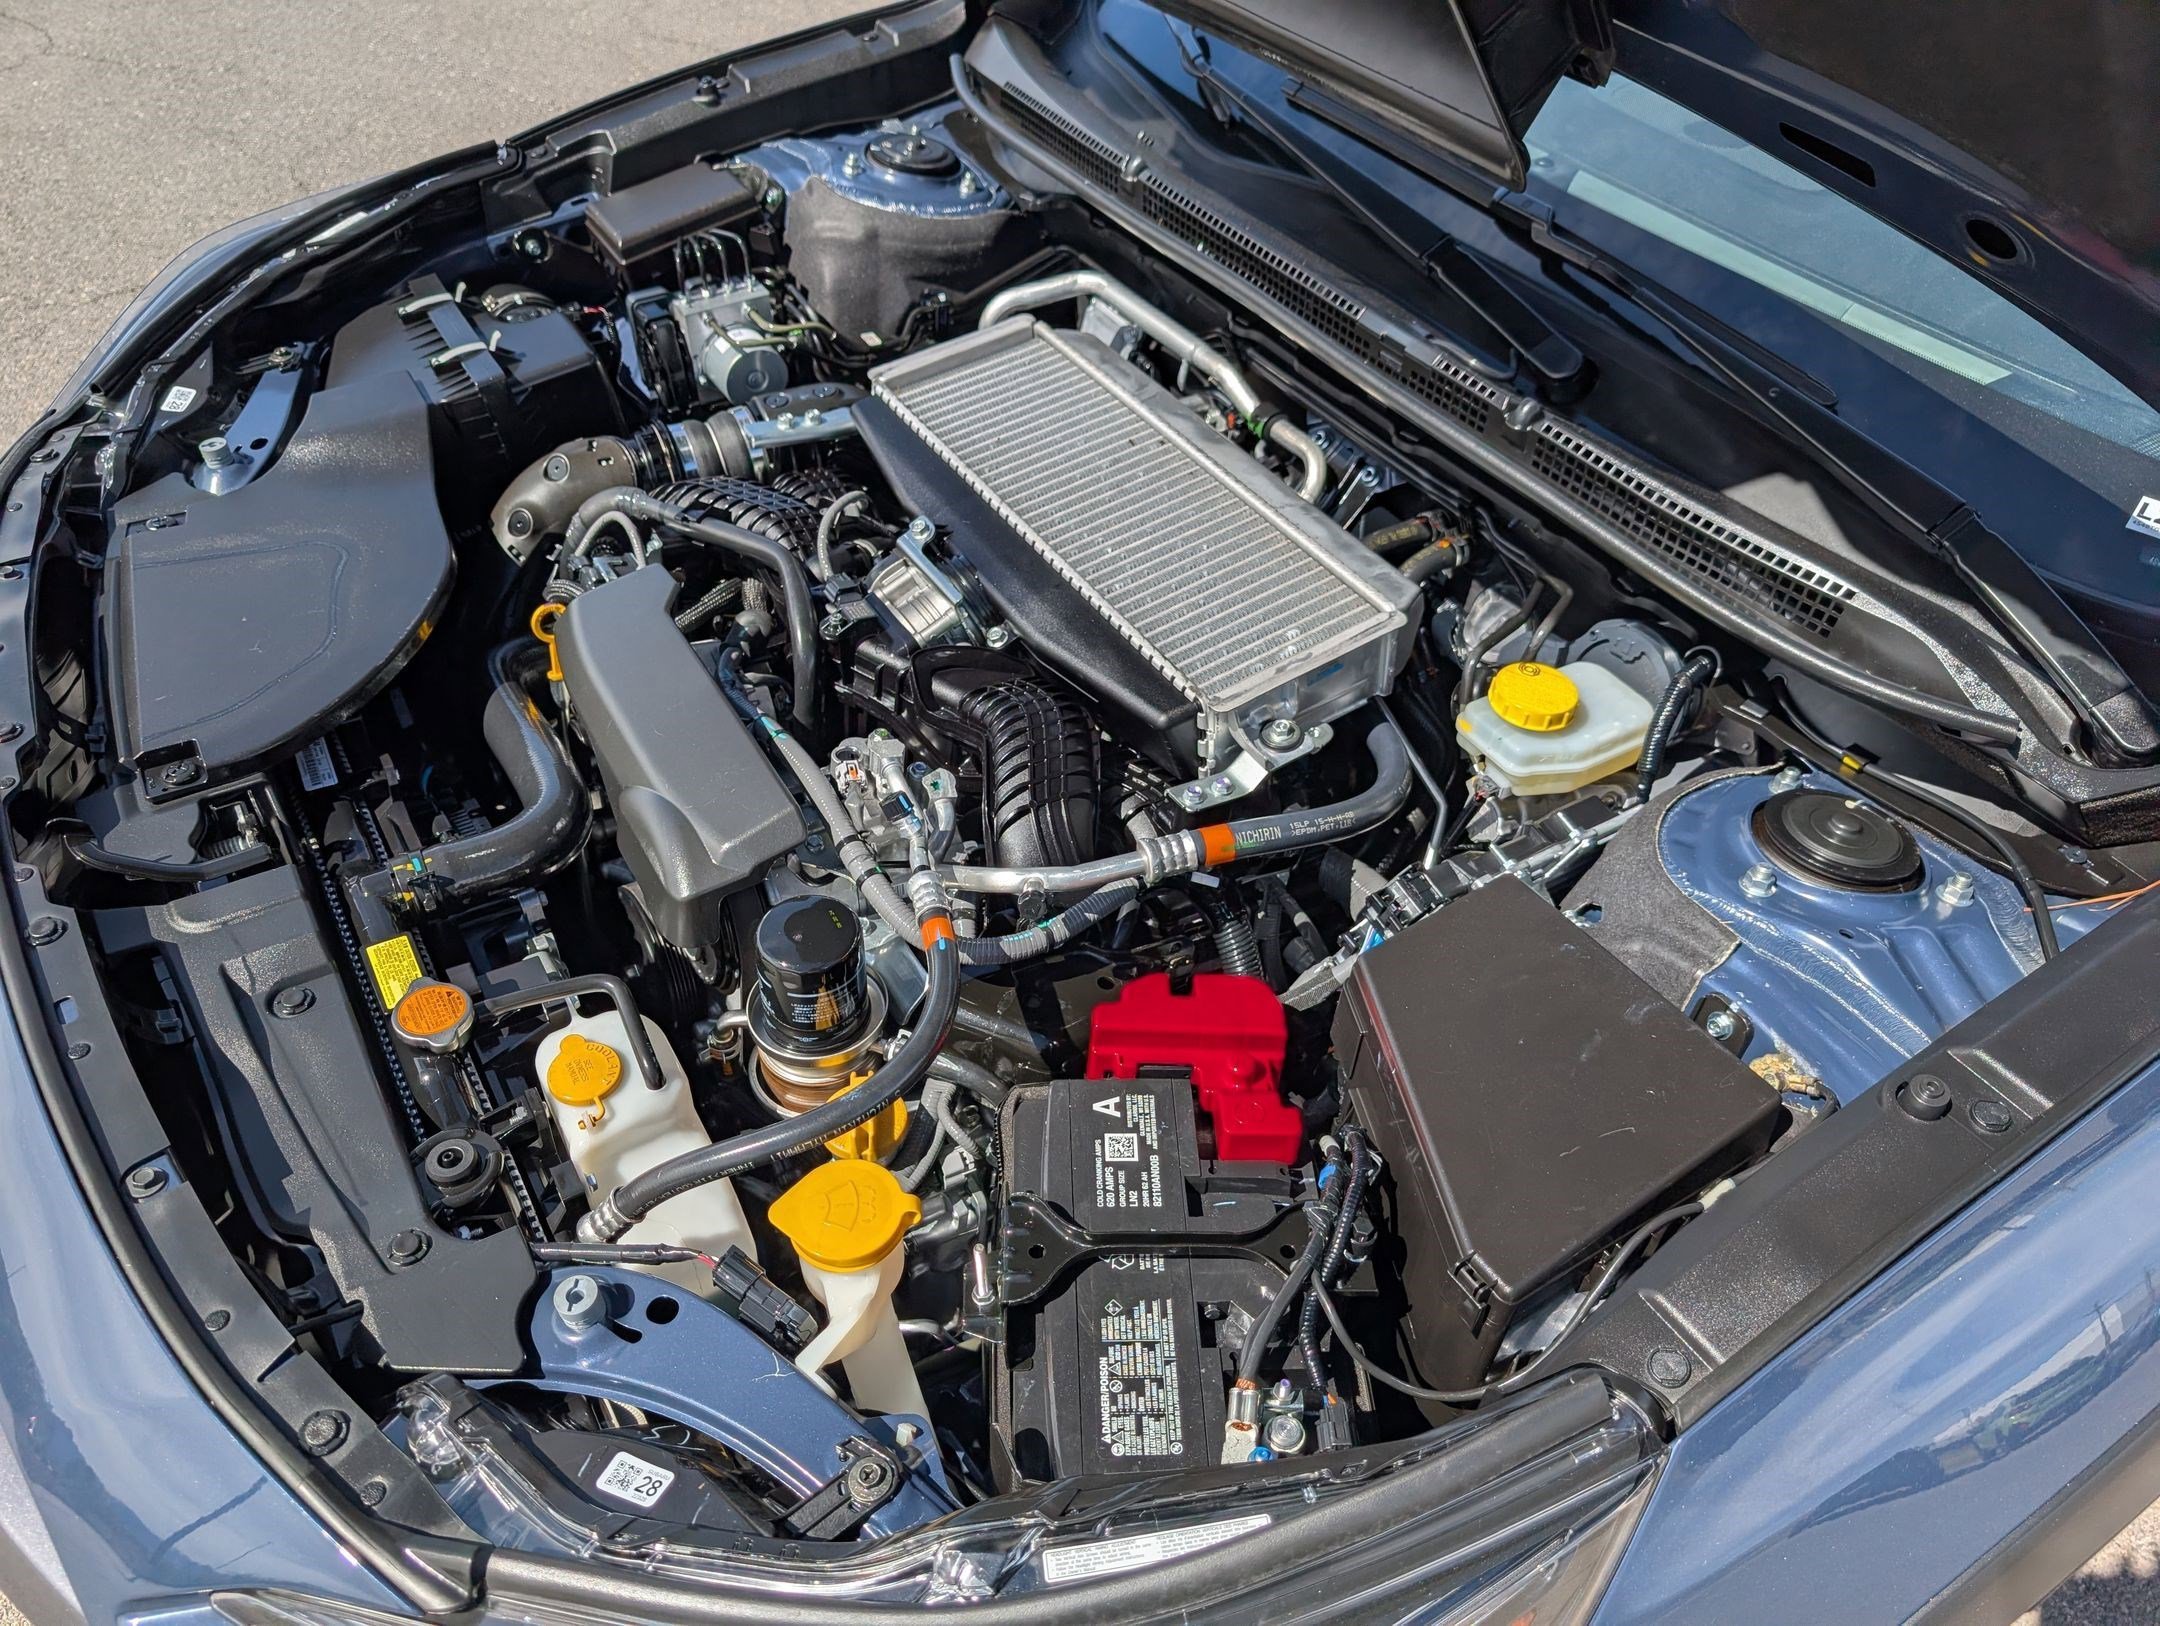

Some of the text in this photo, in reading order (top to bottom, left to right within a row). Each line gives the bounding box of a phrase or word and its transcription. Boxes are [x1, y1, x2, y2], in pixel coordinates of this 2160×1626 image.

[169, 401, 182, 409] 28
[1235, 825, 1282, 845] NICHIRIN
[1093, 1096, 1121, 1117] A
[1141, 1172, 1148, 1181] AH
[1150, 1155, 1162, 1207] 82110AN00B
[1105, 1167, 1115, 1207] 620 AMPS
[1129, 1190, 1138, 1207] LN2
[1100, 1357, 1110, 1433] DANGER/POISON
[634, 1476, 663, 1496] 28
